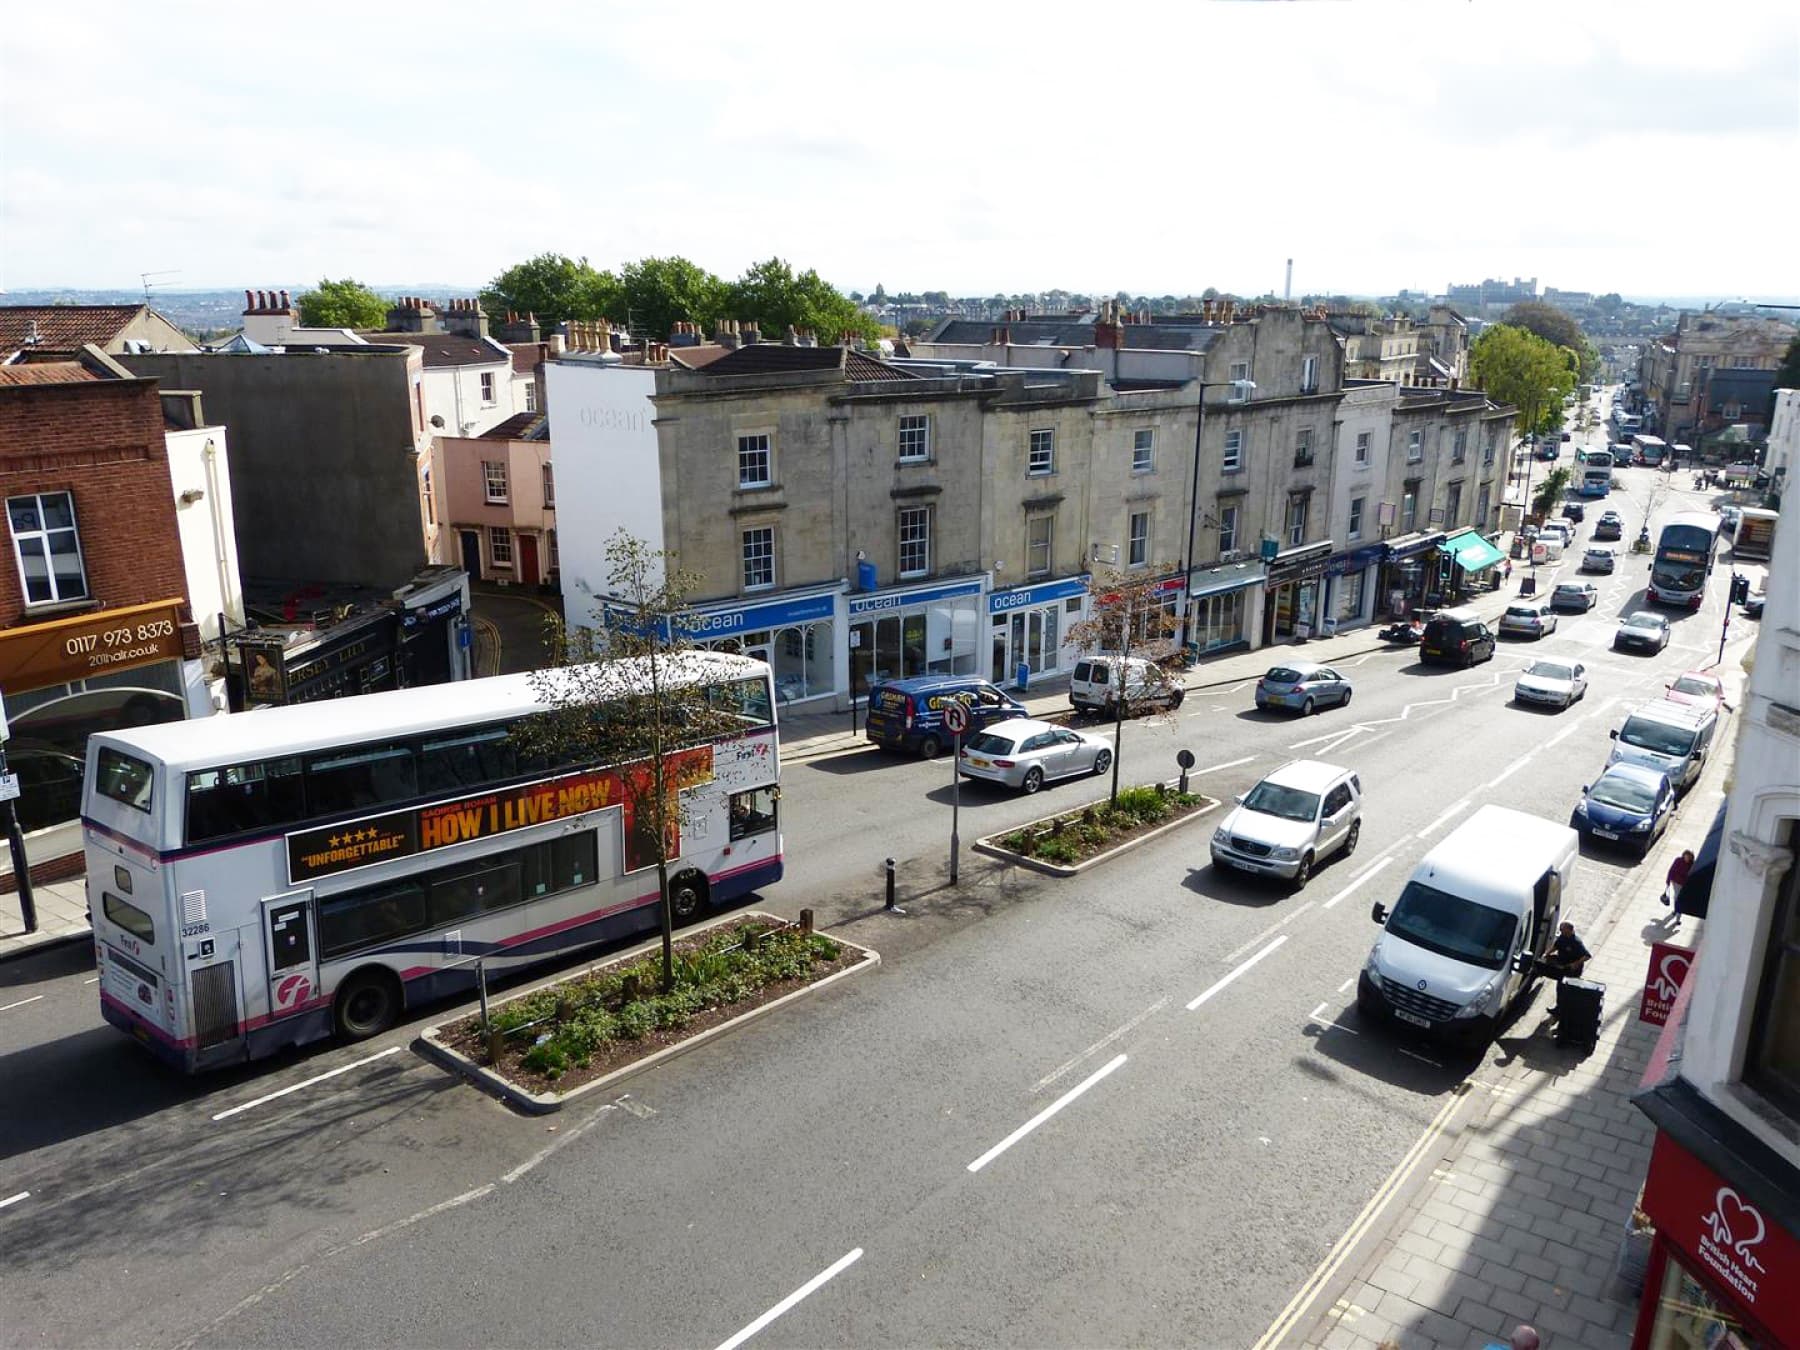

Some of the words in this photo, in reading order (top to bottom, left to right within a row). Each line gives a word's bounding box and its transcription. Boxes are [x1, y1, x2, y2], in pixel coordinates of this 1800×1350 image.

[579, 406, 644, 432] ocean
[855, 594, 900, 612] ocean
[994, 591, 1031, 609] ocean
[690, 612, 743, 633] ocean
[66, 634, 97, 655] 0117
[103, 628, 132, 647] 973
[137, 620, 174, 641] 8373
[88, 643, 159, 667] 201hair.co.uk
[288, 657, 330, 687] ERSEY
[421, 808, 483, 849] HOW
[489, 803, 498, 833] I
[504, 791, 555, 829] LIVE
[558, 778, 612, 817] NOW
[1698, 1244, 1755, 1303] Foundation
[1700, 1234, 1730, 1267] British
[1730, 1261, 1758, 1292] Heart
